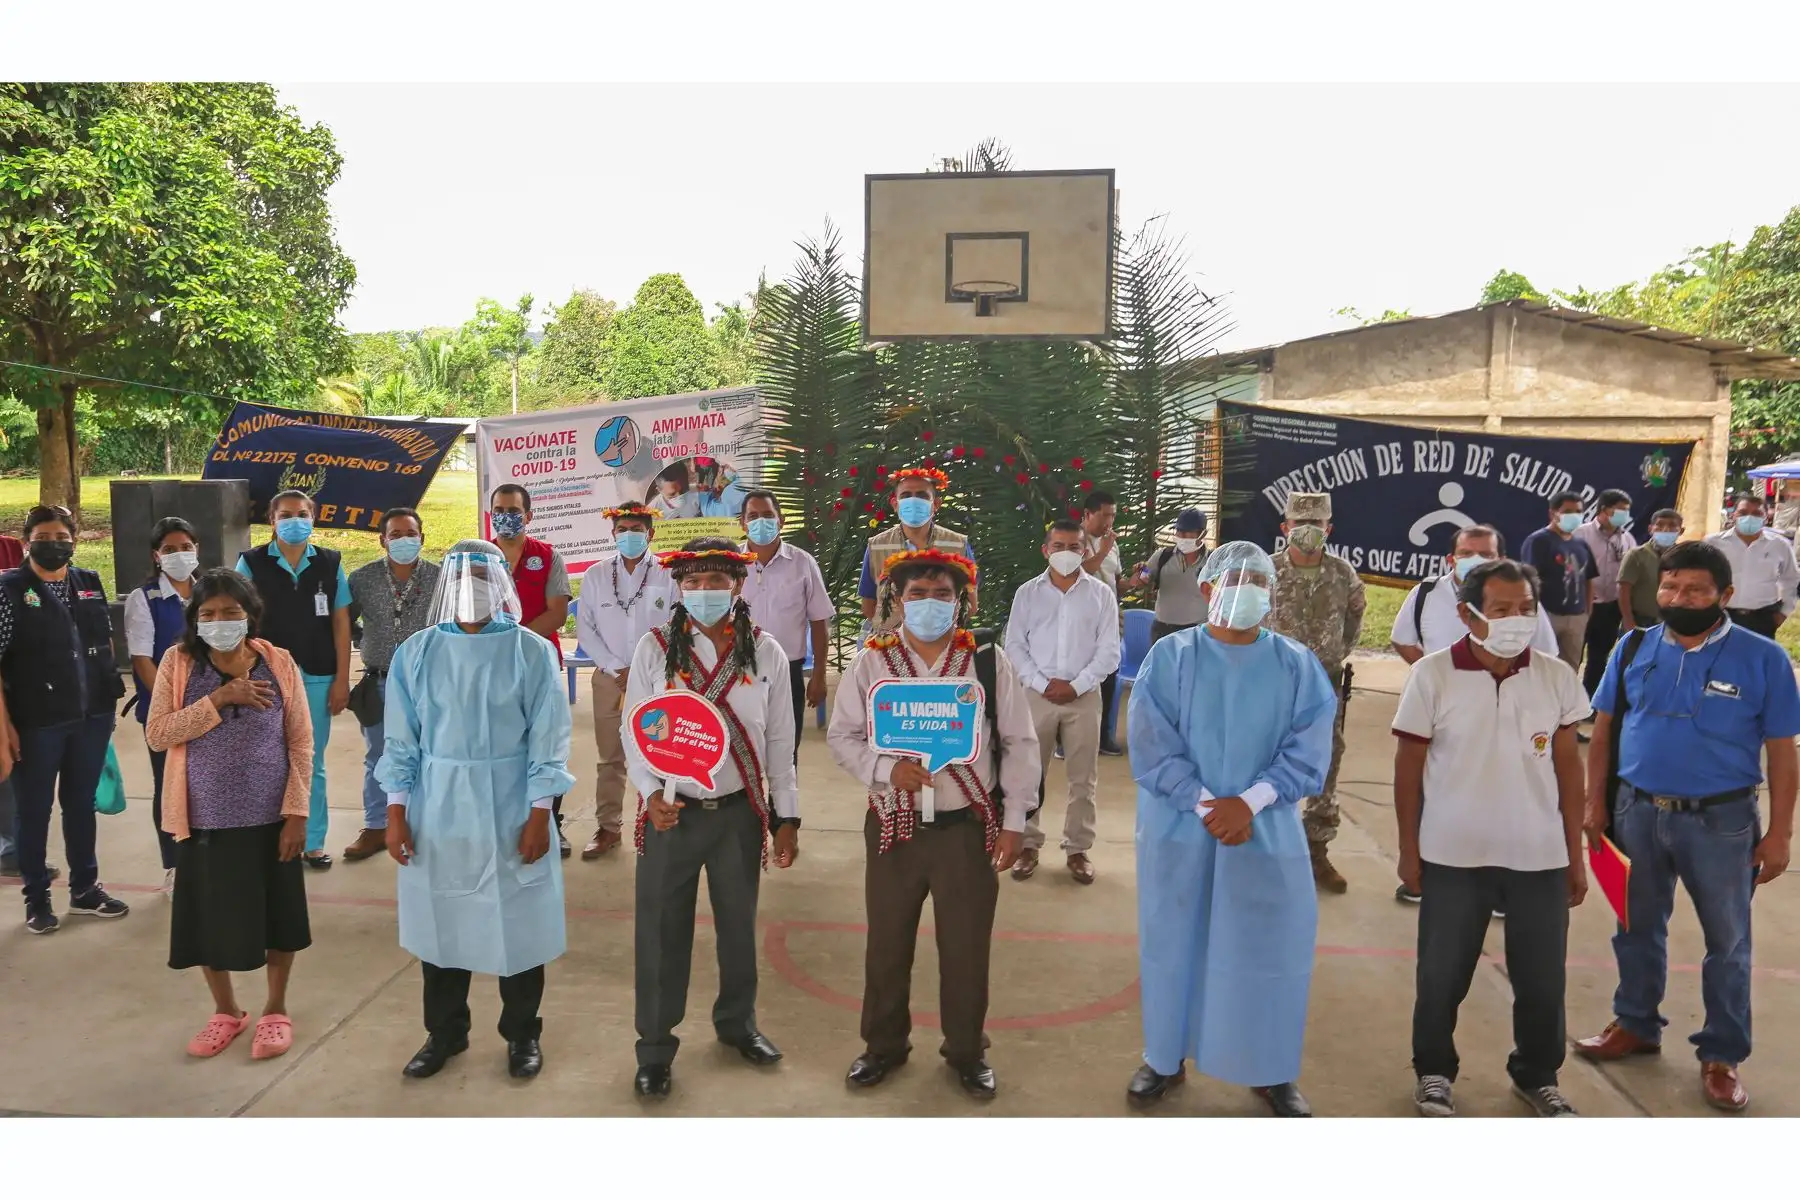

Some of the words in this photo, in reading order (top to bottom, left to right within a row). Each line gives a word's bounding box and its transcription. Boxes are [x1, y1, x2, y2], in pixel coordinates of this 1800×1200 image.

[652, 413, 726, 434] AMPIMATA
[494, 430, 577, 453] VACÚNATE
[526, 448, 562, 460] contra
[566, 446, 576, 456] la
[652, 442, 708, 459] COVID-19
[212, 450, 230, 461] DL
[251, 451, 297, 464] 22175
[304, 452, 390, 472] CONVENIO
[394, 462, 422, 475] 169
[512, 458, 576, 477] COVID-19
[1262, 448, 1368, 516] DIRECCIÓN
[1374, 442, 1404, 476] DE
[1414, 440, 1455, 473] RED
[1464, 444, 1494, 478] DE
[1500, 452, 1572, 500] SALUD
[1368, 549, 1402, 574] QUE
[910, 702, 959, 718] VACUNA
[676, 716, 702, 730] Pongo
[901, 720, 916, 730] ES
[672, 735, 688, 744] por
[688, 738, 698, 746] el
[698, 742, 718, 752] Perú
[684, 728, 716, 742] hombro
